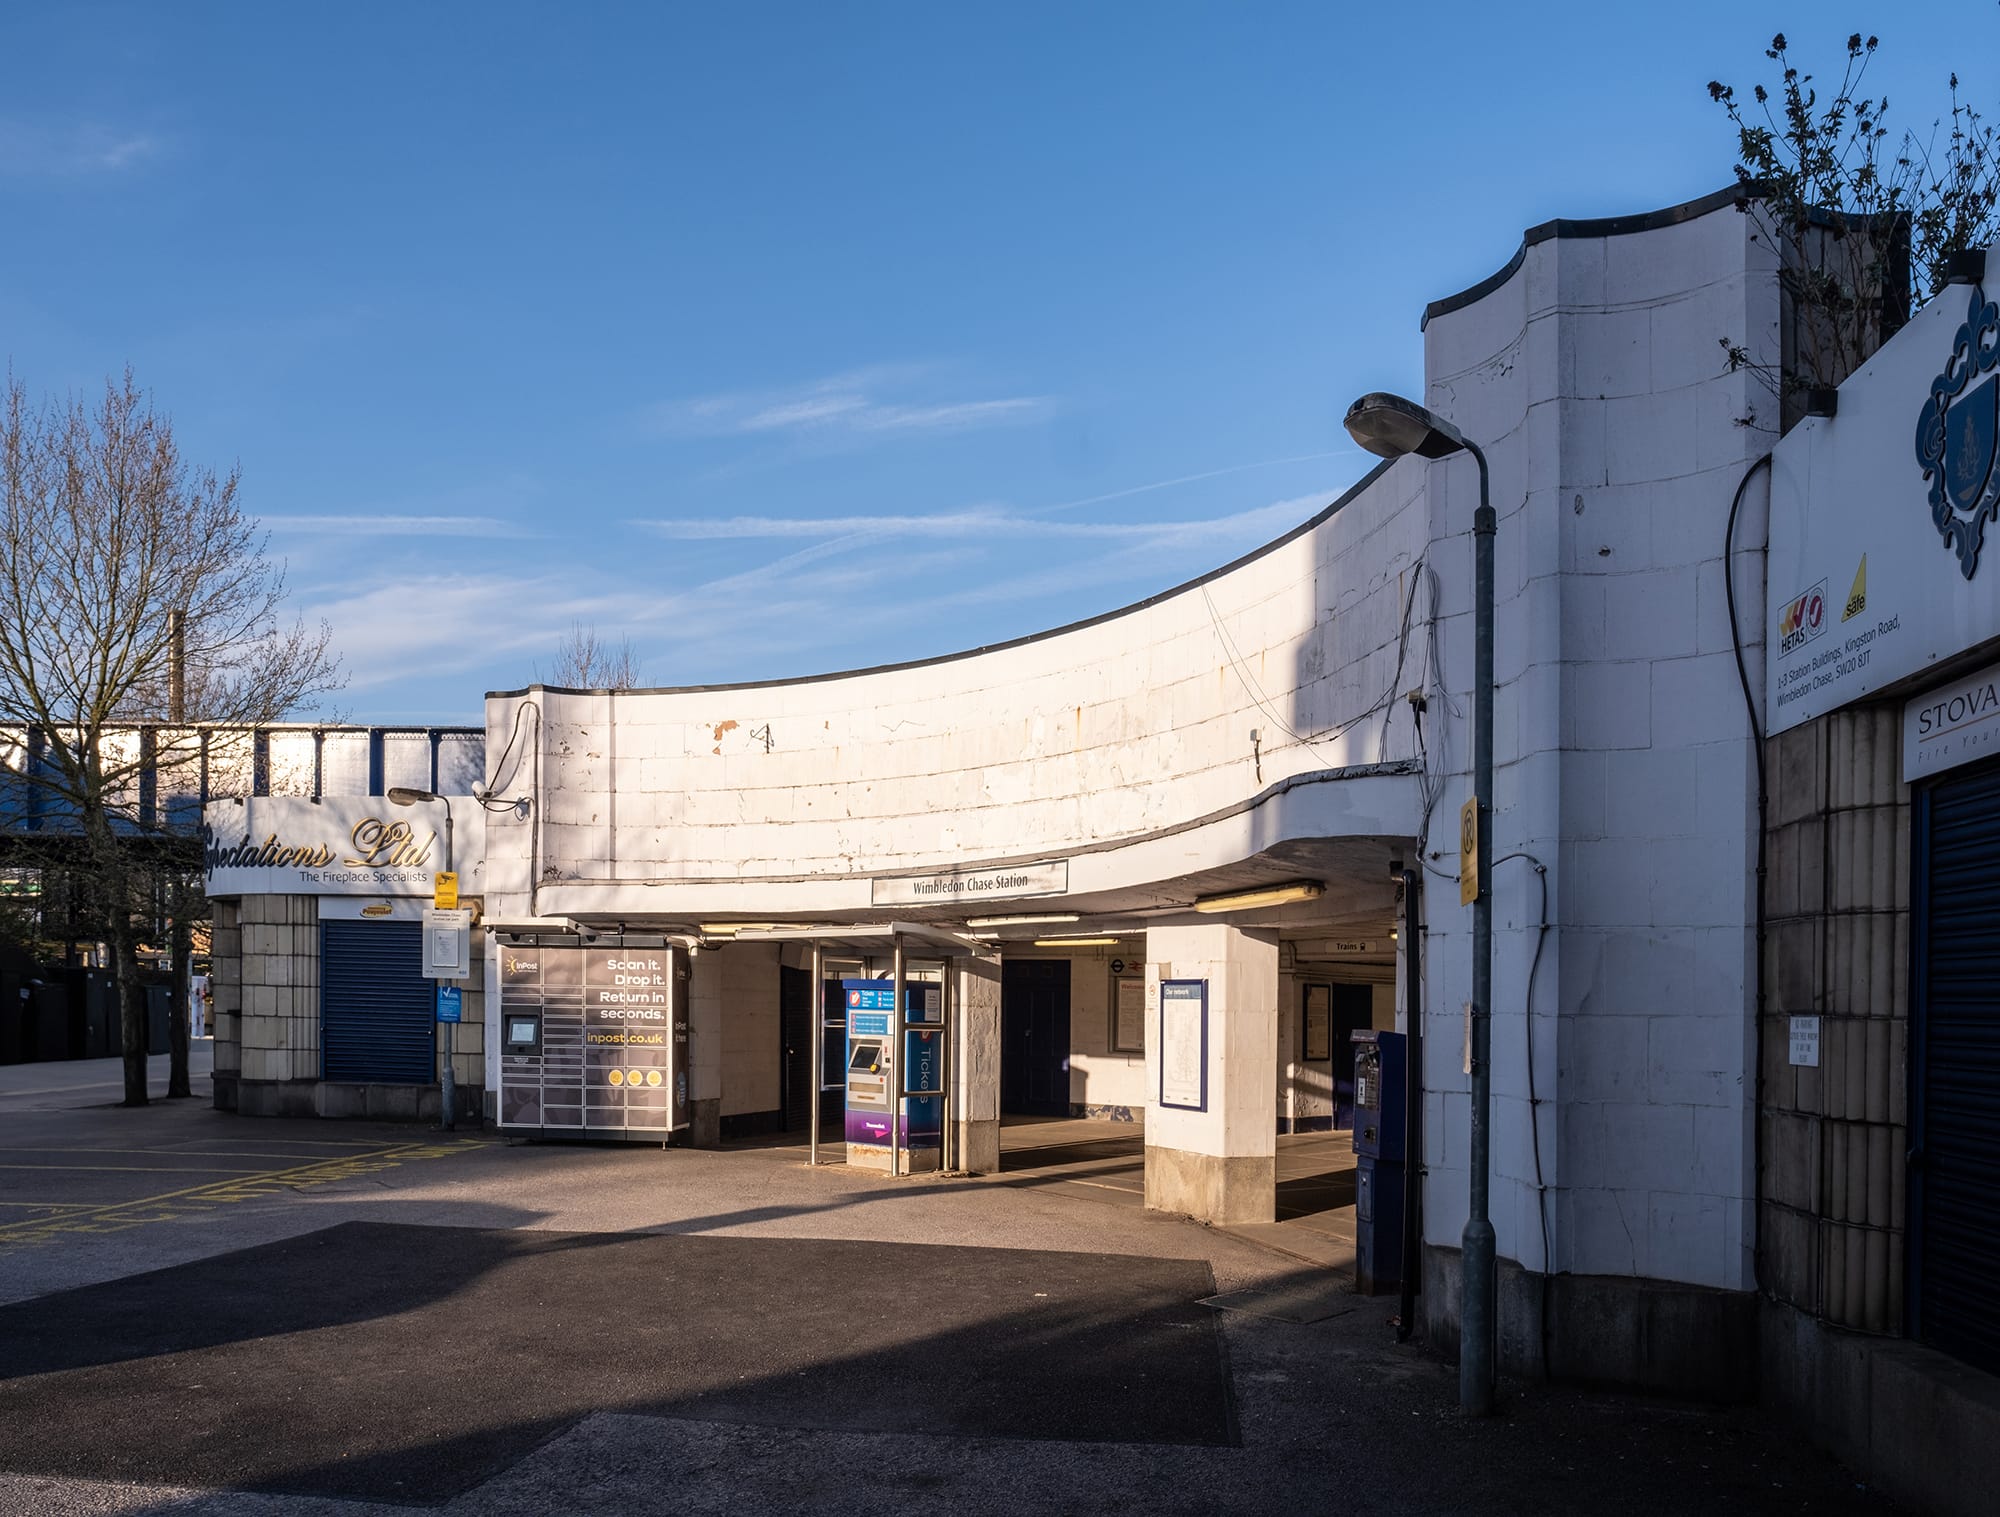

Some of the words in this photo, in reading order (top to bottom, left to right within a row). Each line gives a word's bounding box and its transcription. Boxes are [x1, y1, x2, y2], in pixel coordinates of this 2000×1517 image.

[1781, 627, 1805, 654] HETAS
[1777, 674, 1788, 689] 1-3
[1789, 662, 1811, 683] Station
[1812, 648, 1843, 672] Buildings,
[1845, 630, 1876, 655] Kingston
[1878, 613, 1901, 636] Road,
[1777, 682, 1812, 708] Wimbledon
[1812, 672, 1834, 691] Chase,
[1836, 659, 1856, 680] SW20
[1857, 649, 1872, 669] 8JT
[1918, 745, 1949, 764] Fire
[343, 816, 438, 869] Ltd
[300, 871, 319, 882] The
[322, 871, 369, 884] Fireplace
[373, 871, 427, 884] Specialists
[913, 878, 965, 895] Wimbledon
[967, 876, 993, 892] Chase
[996, 873, 1028, 889] Station
[1336, 942, 1358, 951] Trains
[516, 961, 538, 970] InPost
[607, 959, 646, 971] Scan
[648, 959, 661, 971] it.
[614, 974, 650, 987] Drop
[653, 974, 665, 986] it.
[600, 991, 650, 1003] Return
[652, 991, 665, 1003] in
[600, 1008, 665, 1020] seconds.
[587, 1032, 664, 1044] inpost.co.uk
